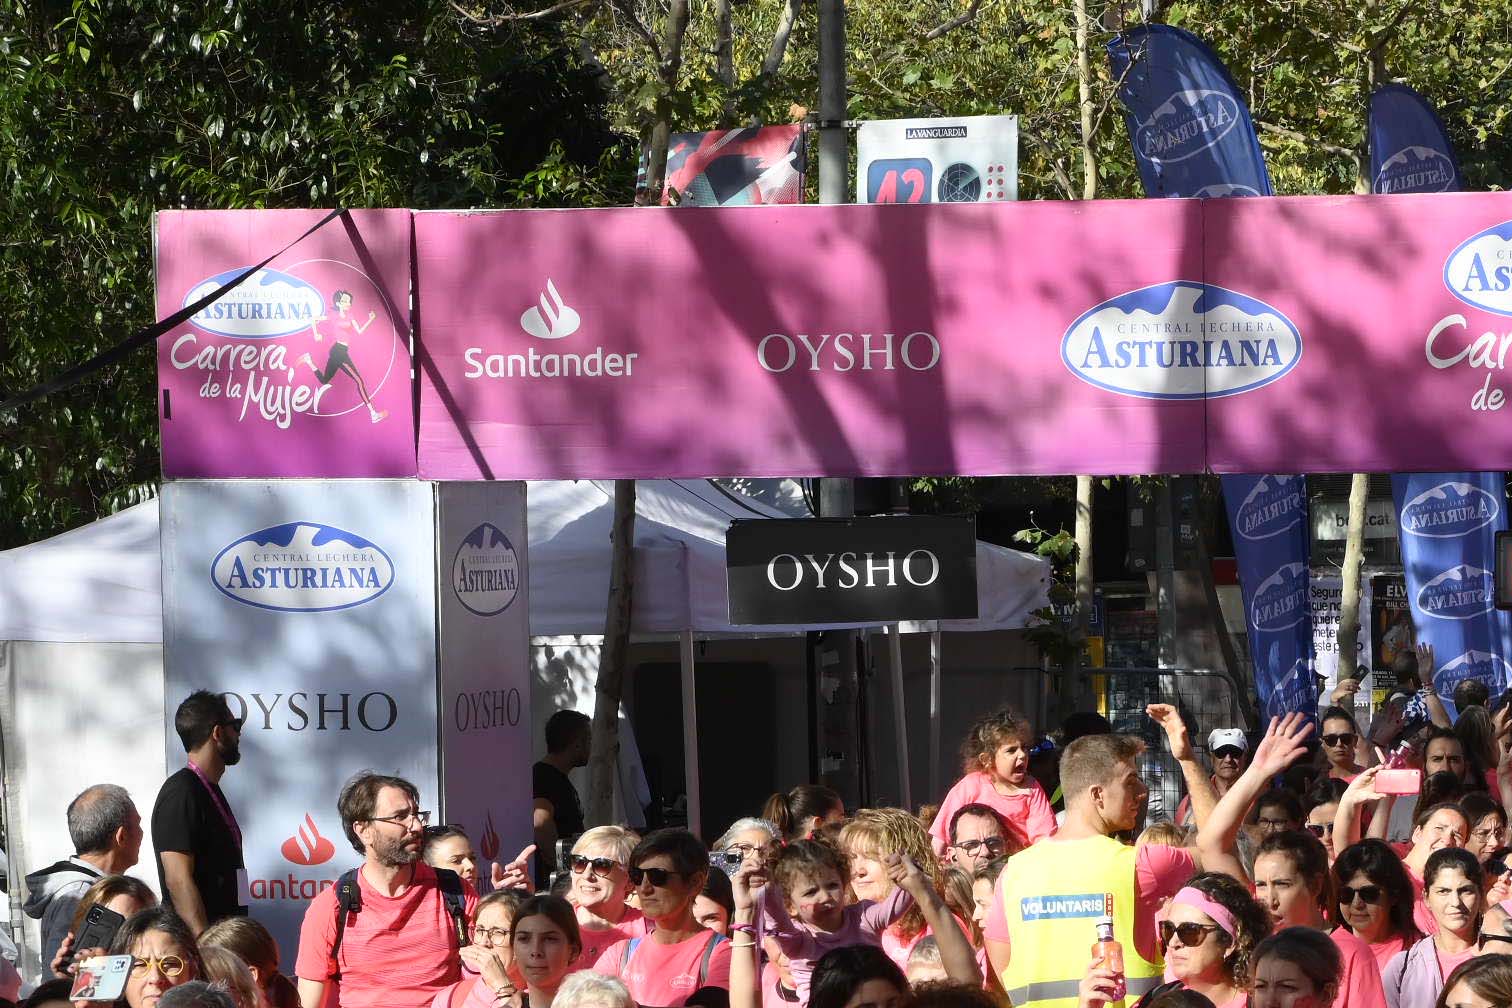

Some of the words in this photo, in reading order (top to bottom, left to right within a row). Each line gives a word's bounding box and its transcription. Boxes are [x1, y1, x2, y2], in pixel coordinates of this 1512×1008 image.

[194, 294, 313, 319] ASTURIANA
[1116, 321, 1194, 335] CENTRAL
[1200, 319, 1277, 334] LECHERA
[170, 334, 288, 371] Carrera
[464, 347, 639, 379] Santander
[757, 331, 941, 373] OYSHO
[1080, 326, 1284, 369] ASTURIANA
[199, 374, 221, 399] de
[226, 371, 242, 400] la
[239, 367, 332, 428] Mujer
[1471, 371, 1507, 411] de
[225, 556, 382, 590] ASTURIANA
[253, 552, 311, 563] CENTRAL
[316, 552, 376, 563] LECHERA
[458, 559, 516, 593] ASTURIANA
[767, 548, 940, 592] OYSHO
[223, 691, 399, 733] OYSHO
[455, 688, 521, 732] OYSHO
[1021, 899, 1104, 915] VOLUNTARIS
